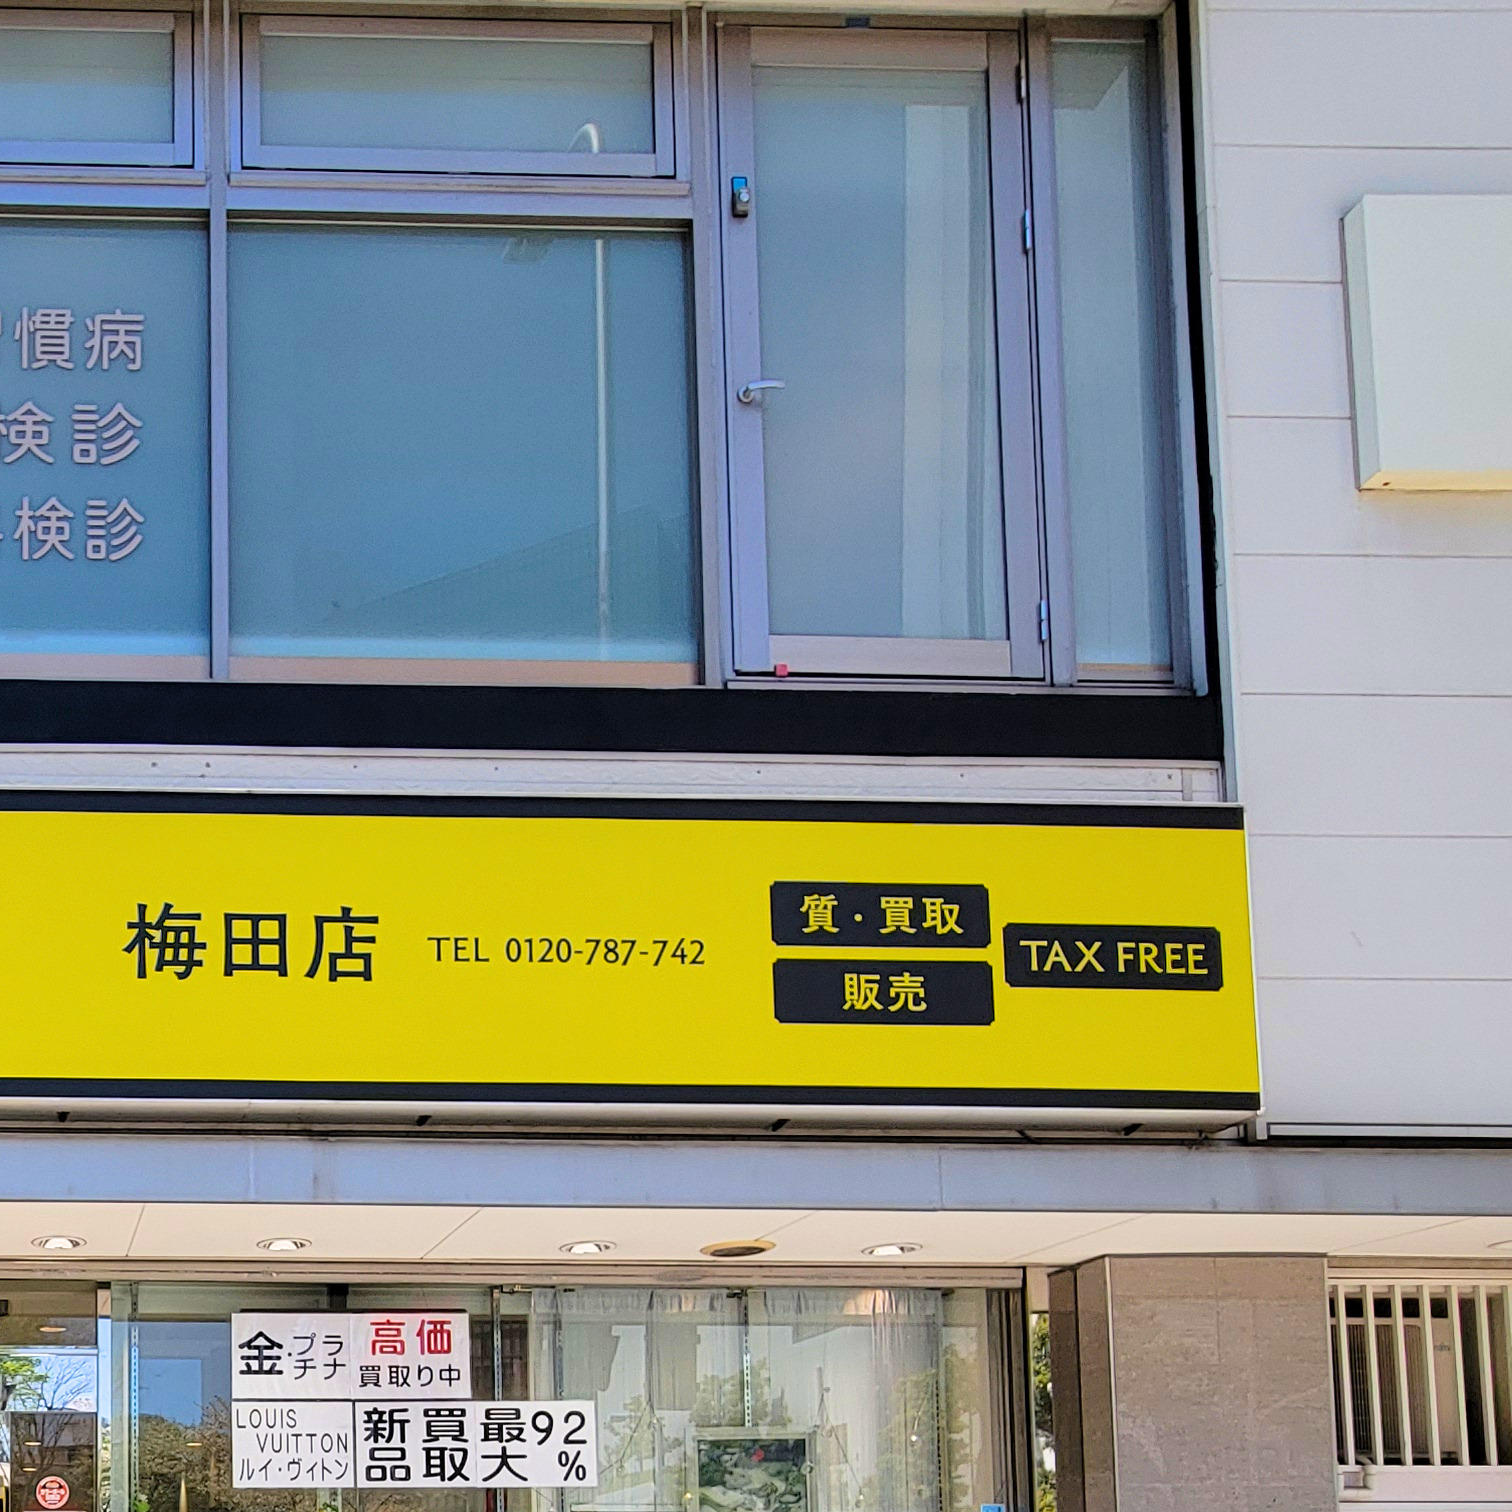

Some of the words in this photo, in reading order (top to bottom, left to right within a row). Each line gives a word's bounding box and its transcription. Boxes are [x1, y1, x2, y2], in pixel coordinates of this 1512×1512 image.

[799, 893, 965, 936] 質・買取
[122, 901, 380, 983] 梅田店
[426, 936, 491, 963] TEL
[504, 936, 707, 967] 0120-787-742
[1019, 939, 1106, 974] TAX
[1116, 941, 1209, 976] FREE
[841, 971, 928, 1013] 販売
[369, 1318, 453, 1357] 高価
[358, 1364, 462, 1389] 買取り中
[236, 1408, 297, 1430] LOUIS
[255, 1432, 349, 1454] VUITTON
[238, 1457, 350, 1483] ルイ・ヴィトン
